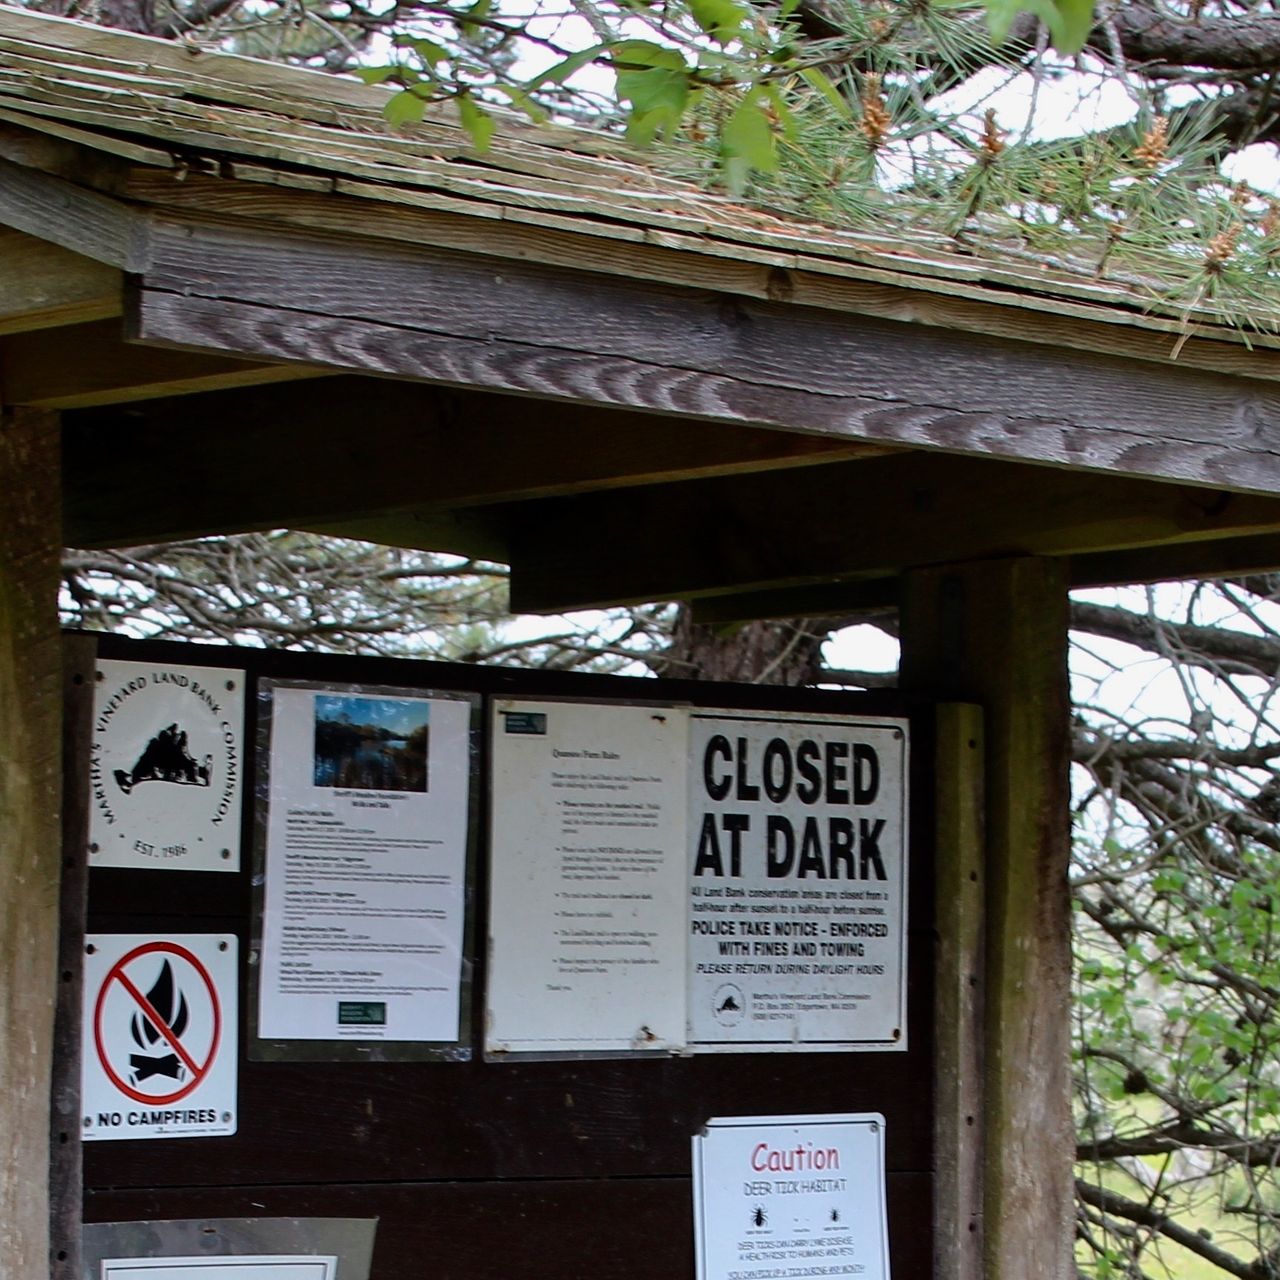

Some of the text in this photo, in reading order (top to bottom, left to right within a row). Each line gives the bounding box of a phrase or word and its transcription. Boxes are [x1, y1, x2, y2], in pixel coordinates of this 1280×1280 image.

[152, 672, 190, 688] LAND
[190, 681, 223, 716] BANK
[211, 721, 239, 827] COMMISSION
[703, 734, 880, 806] CLOSED
[693, 812, 751, 879] AT
[766, 814, 889, 882] DARK
[704, 887, 723, 898] Land
[725, 887, 745, 898] Bank
[866, 891, 882, 901] from
[729, 903, 749, 913] after
[751, 904, 780, 914] sunset
[781, 905, 789, 914] to
[832, 905, 857, 915] before
[692, 920, 736, 937] POLICE
[738, 921, 771, 937] TAKE
[774, 921, 819, 937] NOTICE
[830, 922, 889, 938] ENFORCED
[718, 941, 866, 957] WITH FINES AND TOWING
[696, 963, 886, 976] PLEASE RETURN DURING DAYLIGHT HOURS
[98, 1109, 217, 1127] NO CAMPFIRES
[751, 1142, 840, 1172] Caution
[743, 1179, 847, 1196] DEER TICK HABITAT
